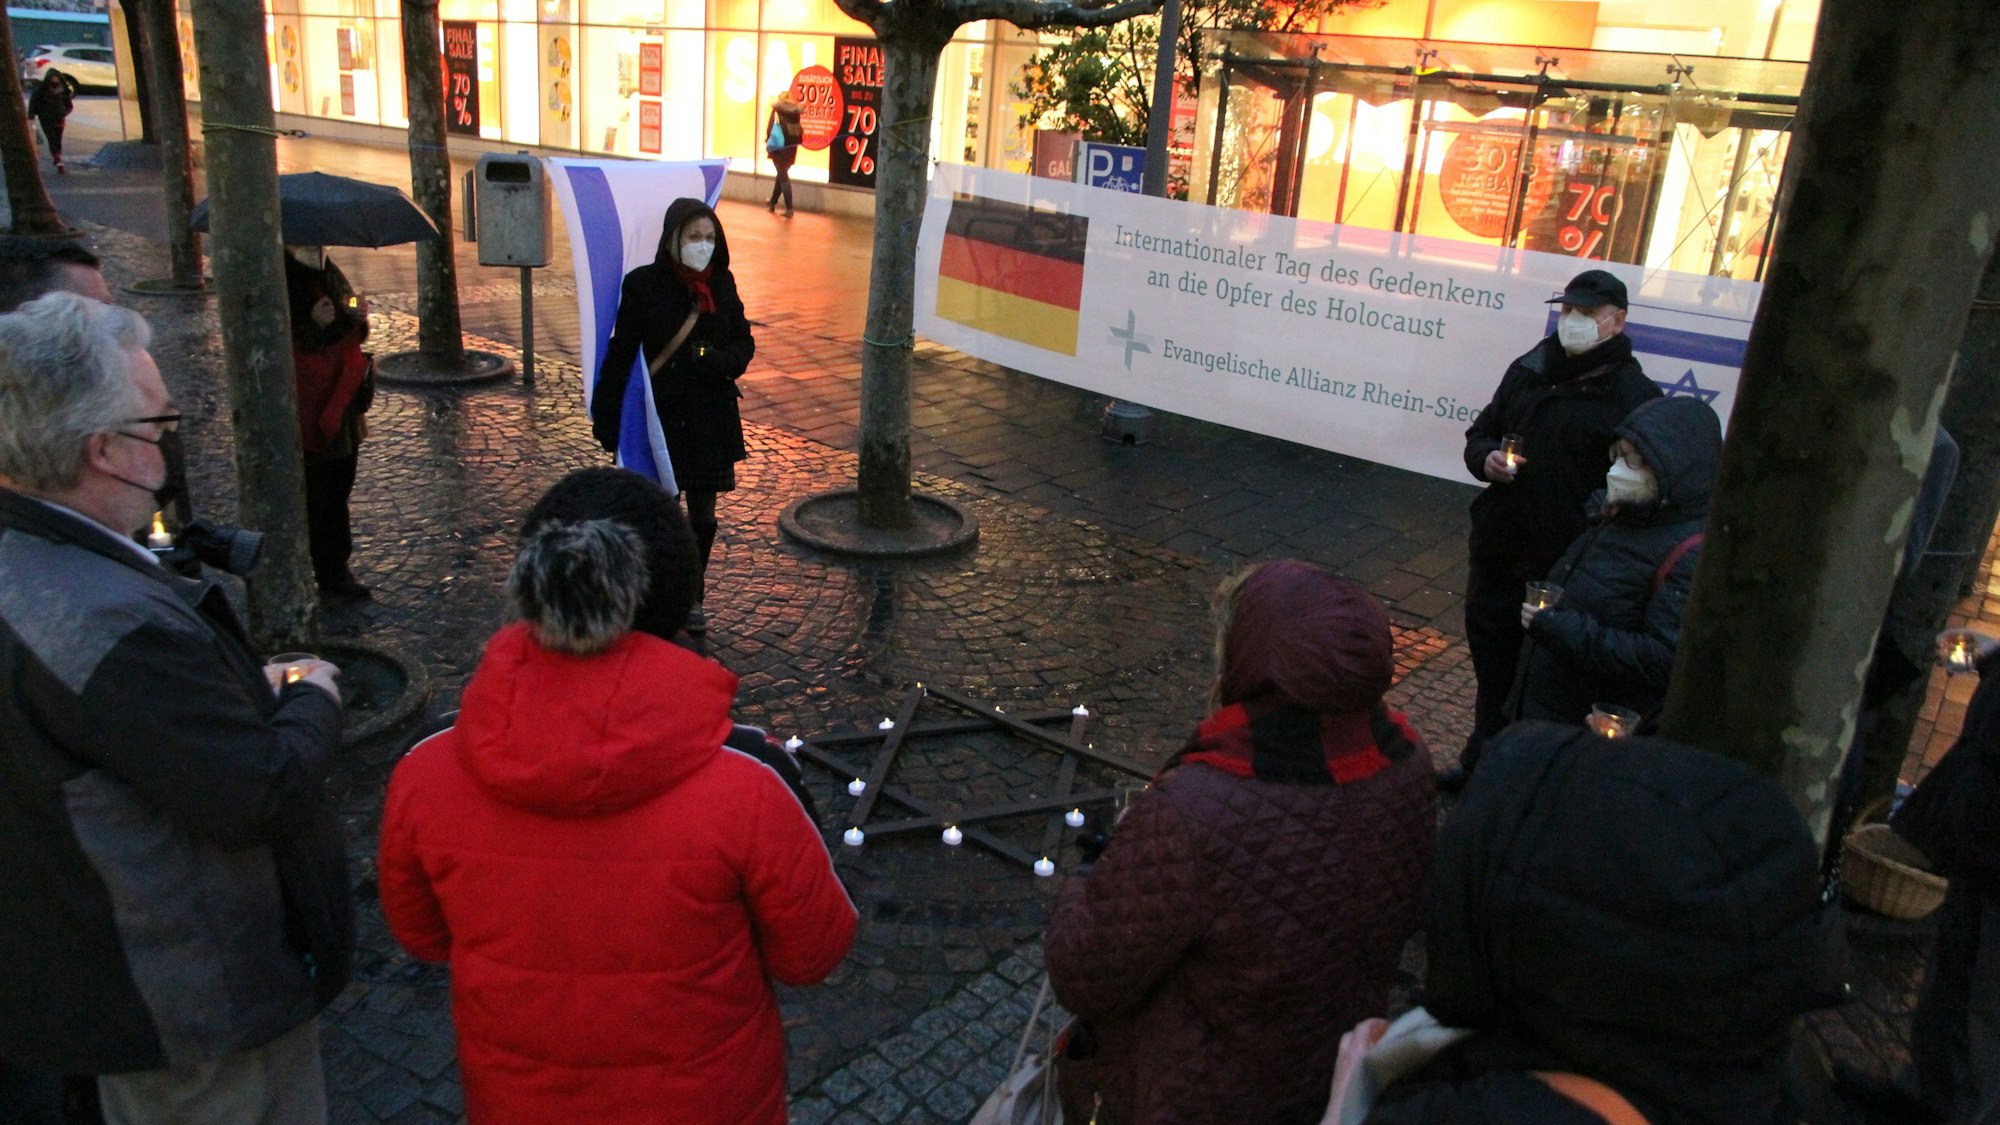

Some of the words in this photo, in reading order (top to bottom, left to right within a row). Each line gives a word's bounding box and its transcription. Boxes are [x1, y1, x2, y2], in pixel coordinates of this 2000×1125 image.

[446, 28, 474, 44] FINAL
[449, 43, 473, 59] SALE
[453, 73, 470, 95] 70
[843, 64, 886, 87] SALE
[453, 96, 471, 126] %
[797, 84, 836, 108] 30%
[801, 105, 835, 119] ABATT
[847, 104, 877, 136] 70
[845, 135, 875, 175] %
[1088, 149, 1114, 188] P
[1114, 224, 1267, 271] Internationaler
[1275, 251, 1311, 284] Tag
[1320, 259, 1359, 286] des
[1368, 266, 1506, 311] Gedenkens
[1147, 270, 1170, 289] an
[1178, 271, 1208, 296] die
[1216, 277, 1273, 308] Opfer
[1280, 290, 1317, 317] des
[1325, 297, 1446, 339] Holocaust
[1162, 339, 1281, 383] Evangelische
[1285, 366, 1357, 399] Allianz
